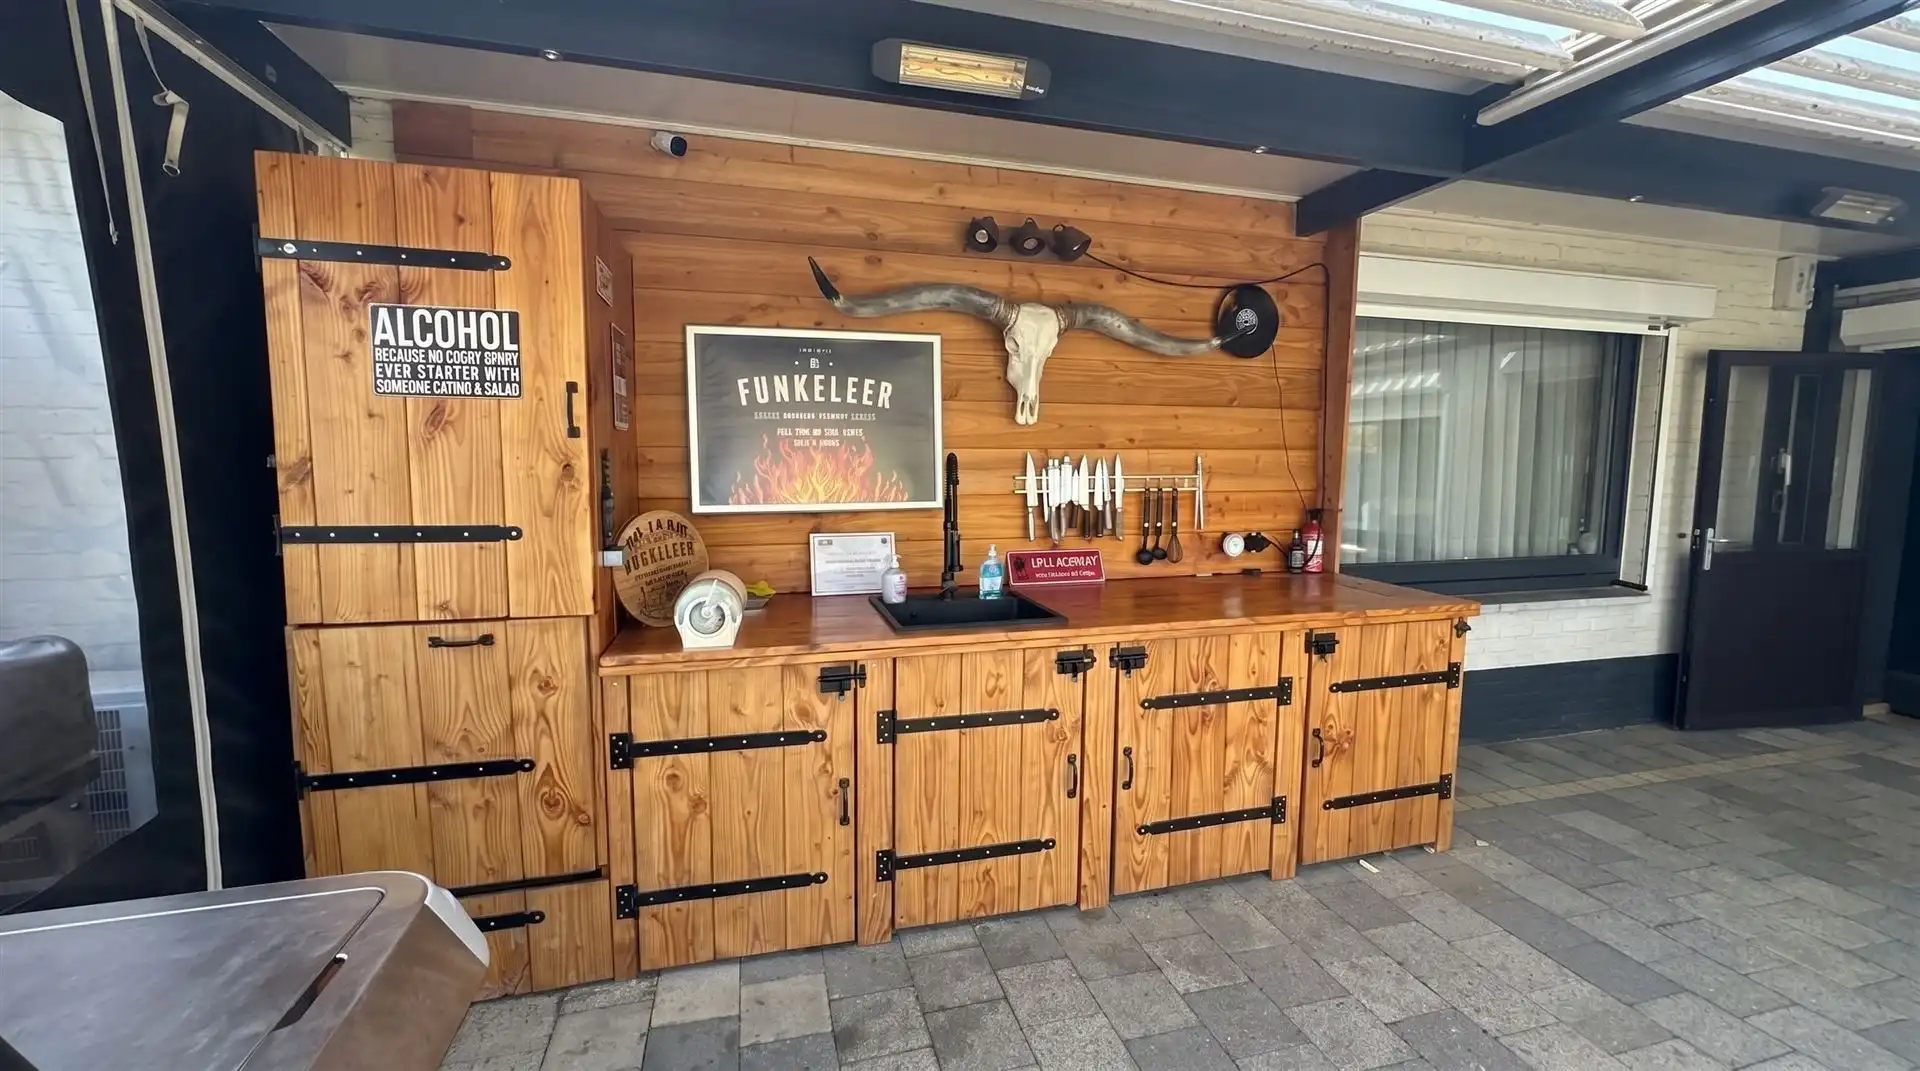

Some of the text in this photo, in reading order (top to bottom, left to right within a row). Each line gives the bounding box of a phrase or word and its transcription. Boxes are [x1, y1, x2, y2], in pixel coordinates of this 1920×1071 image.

[374, 307, 519, 350] ALCOHOL
[375, 347, 426, 363] BECAUSE
[428, 349, 444, 364] NO
[376, 363, 520, 382] EVER STARTER WITH
[376, 379, 432, 395] SOMEONE
[473, 383, 483, 396] &
[484, 383, 520, 397] SALAD
[737, 374, 893, 409] FUNKELEER
